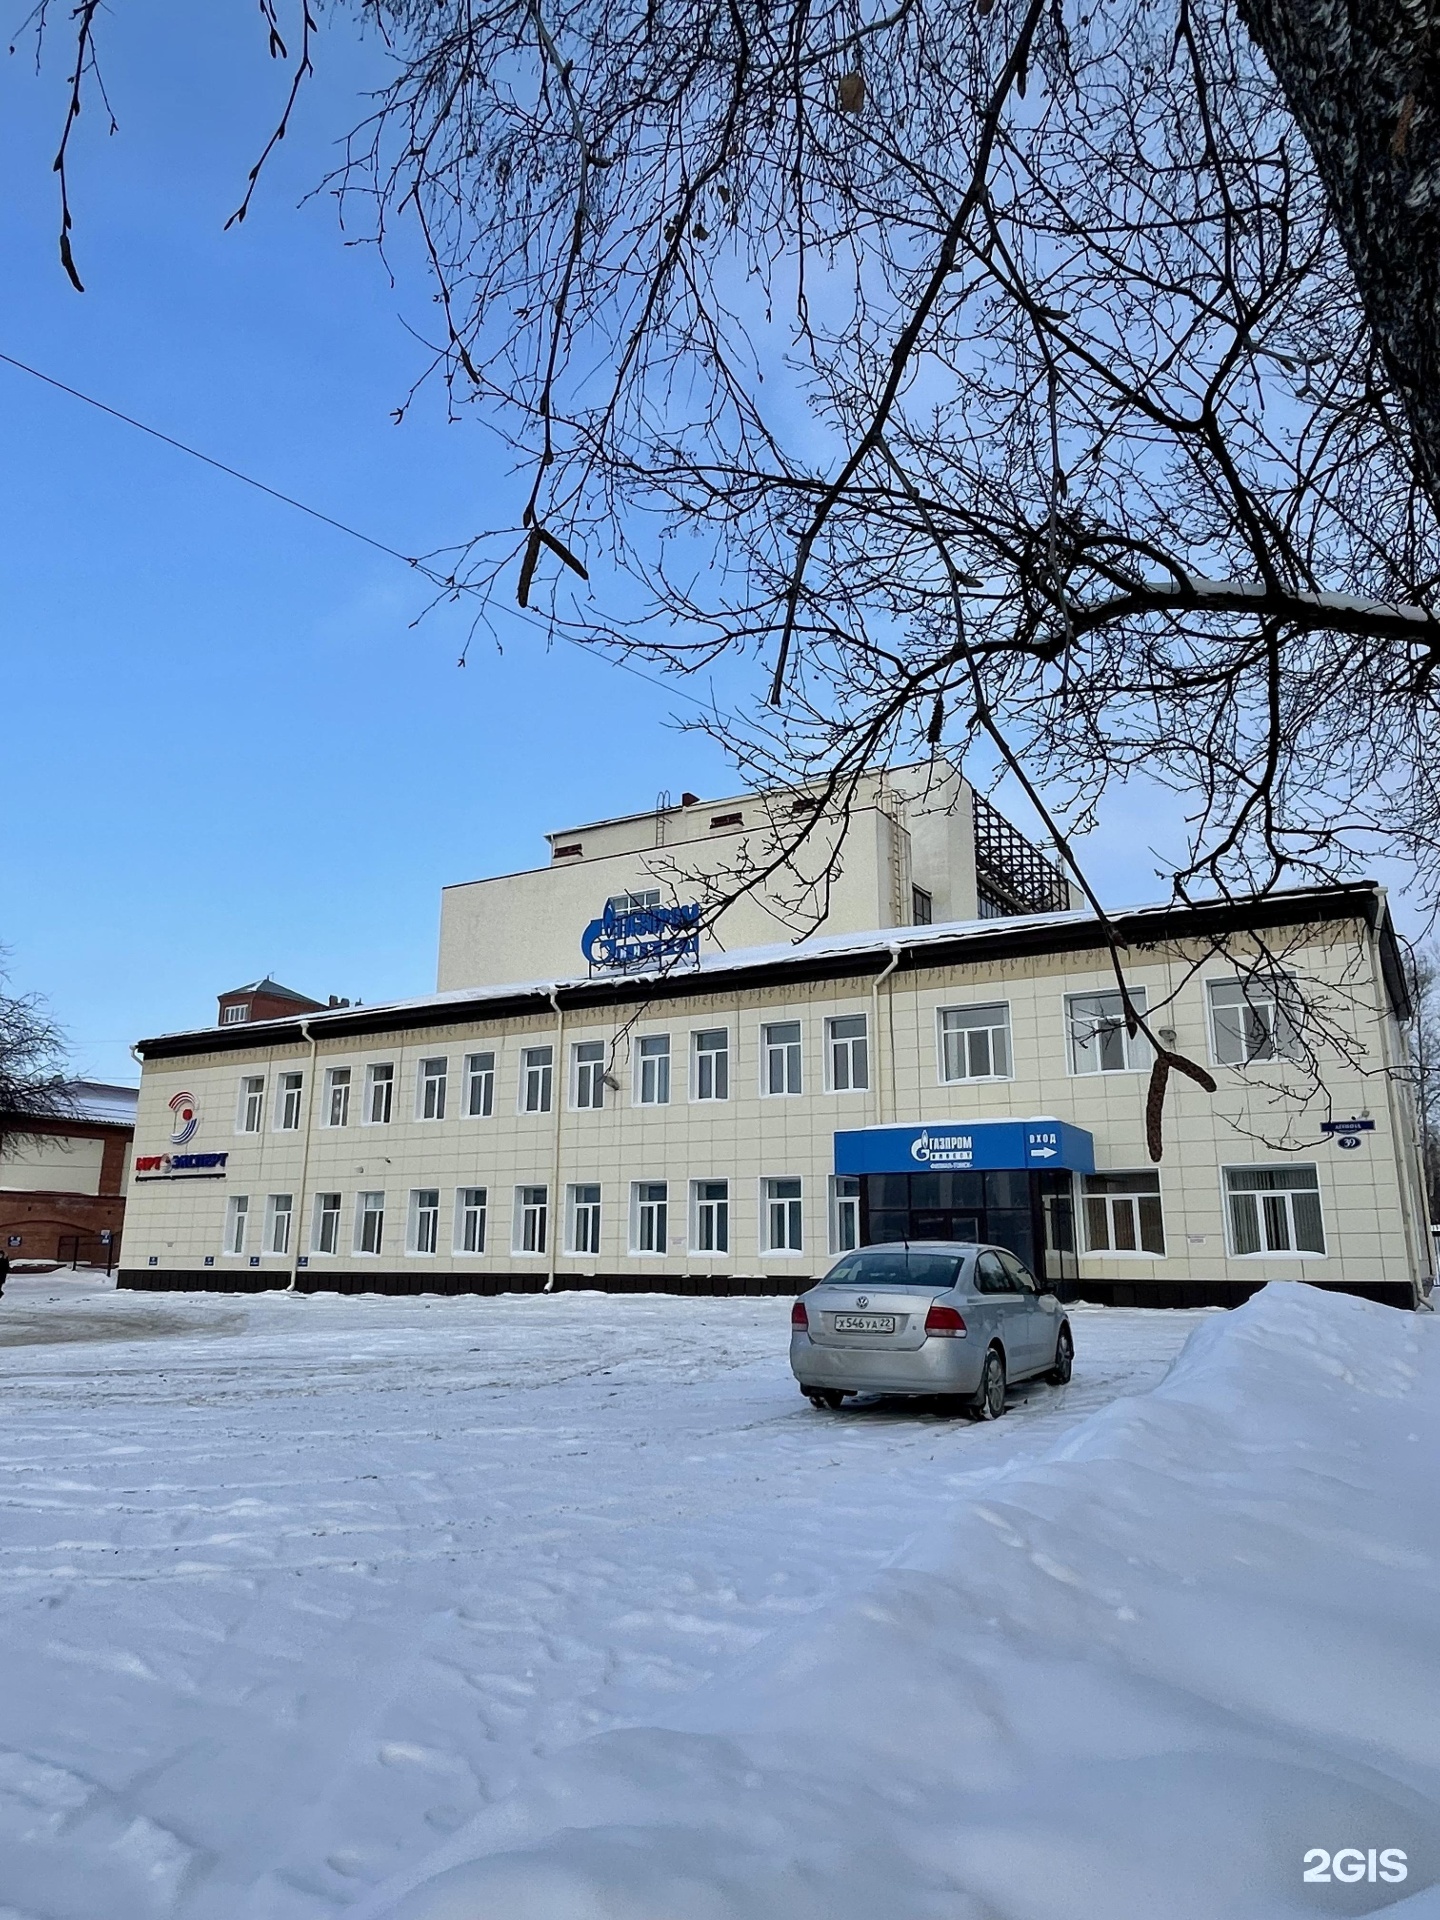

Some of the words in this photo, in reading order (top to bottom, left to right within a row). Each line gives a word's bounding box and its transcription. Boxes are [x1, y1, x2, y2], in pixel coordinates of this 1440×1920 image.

[929, 1136, 972, 1150] ГАЗПРОМ
[1029, 1133, 1056, 1144] ВХОД
[1343, 1138, 1356, 1148] 39
